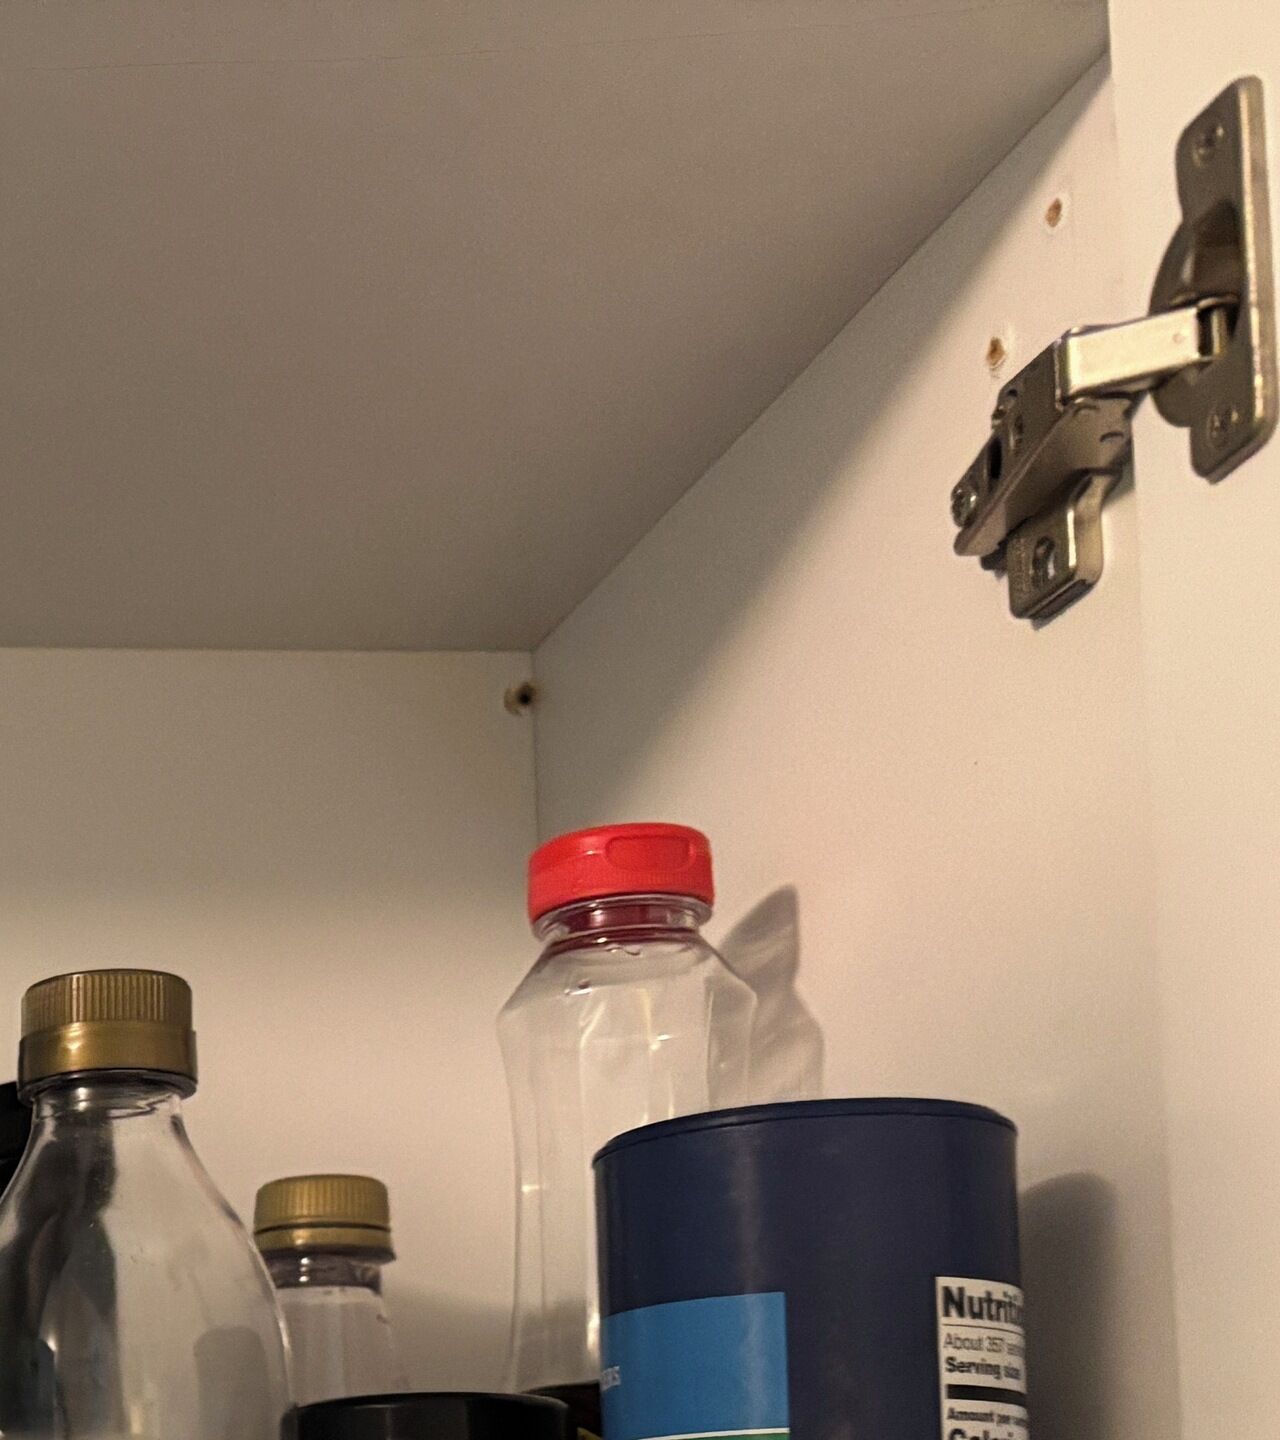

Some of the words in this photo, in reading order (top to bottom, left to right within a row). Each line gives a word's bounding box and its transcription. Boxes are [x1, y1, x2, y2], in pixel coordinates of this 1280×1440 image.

[942, 1286, 1023, 1325] Nutriti
[944, 1333, 982, 1349] About
[945, 1356, 1002, 1379] Serving
